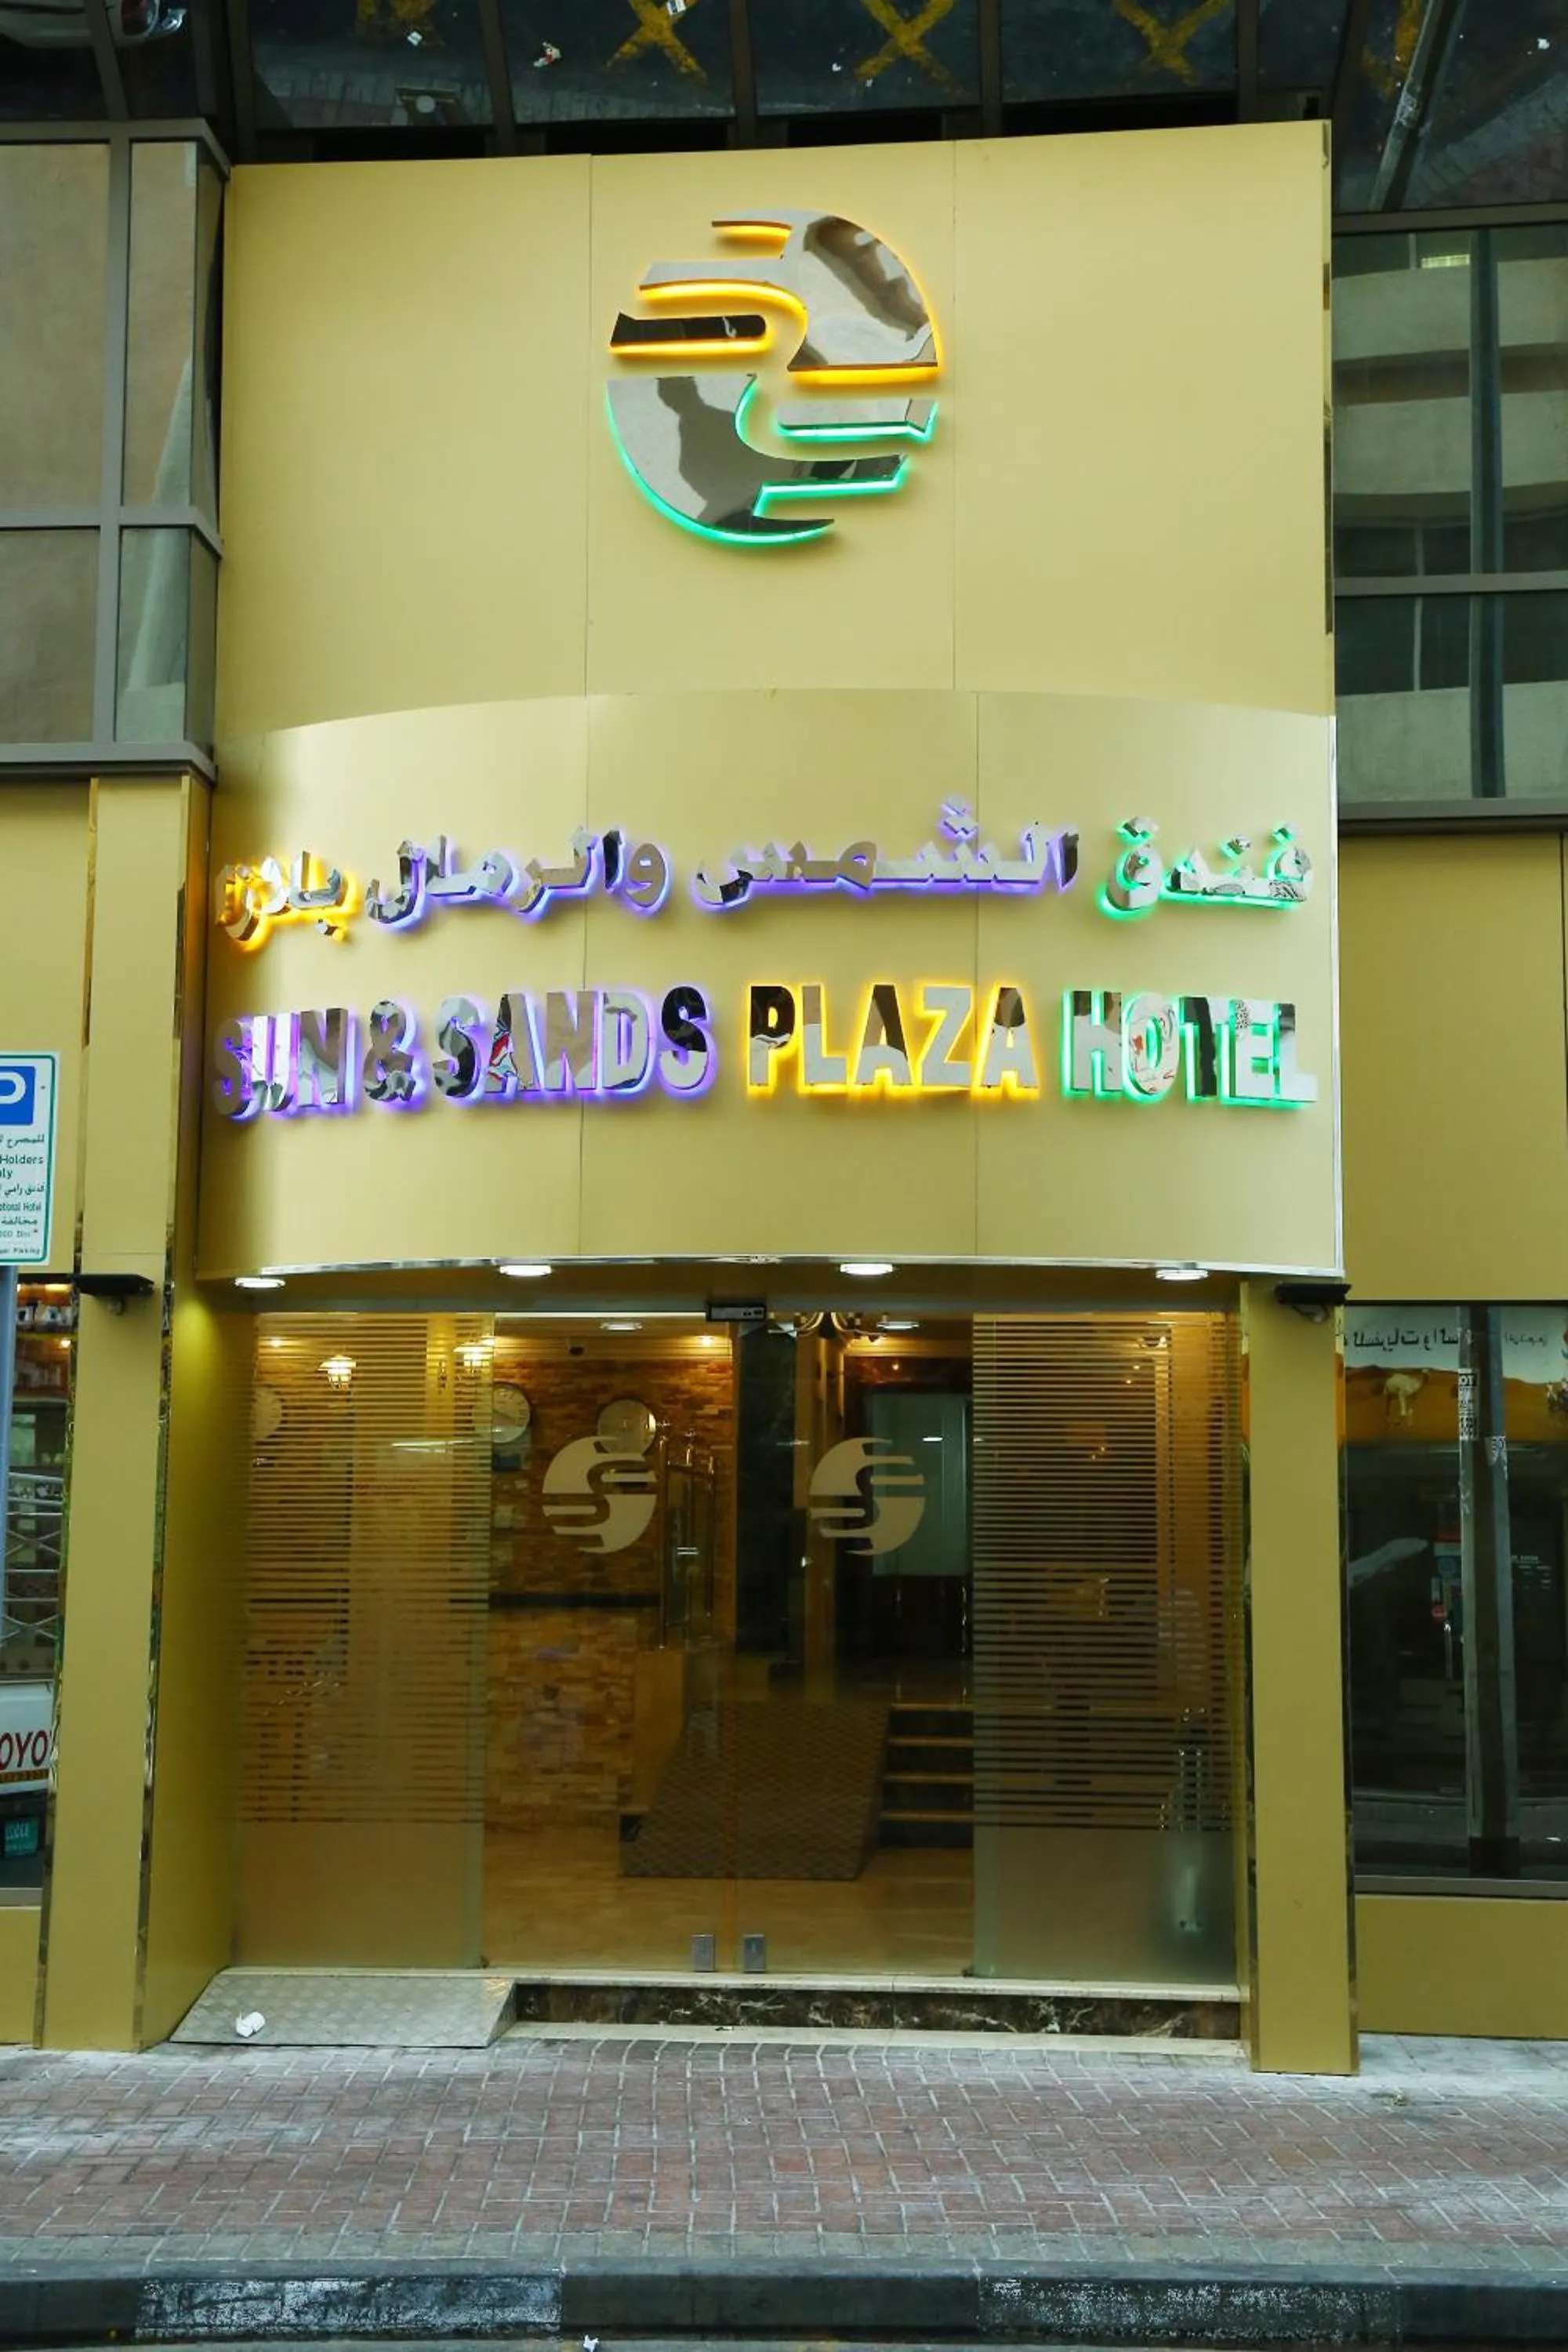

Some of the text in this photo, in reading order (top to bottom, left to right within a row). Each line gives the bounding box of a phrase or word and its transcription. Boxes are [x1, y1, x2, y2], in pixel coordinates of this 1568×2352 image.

[747, 984, 1040, 1096] PLAZA
[1062, 989, 1319, 1105] HOTEL
[0, 1154, 44, 1164] Holders
